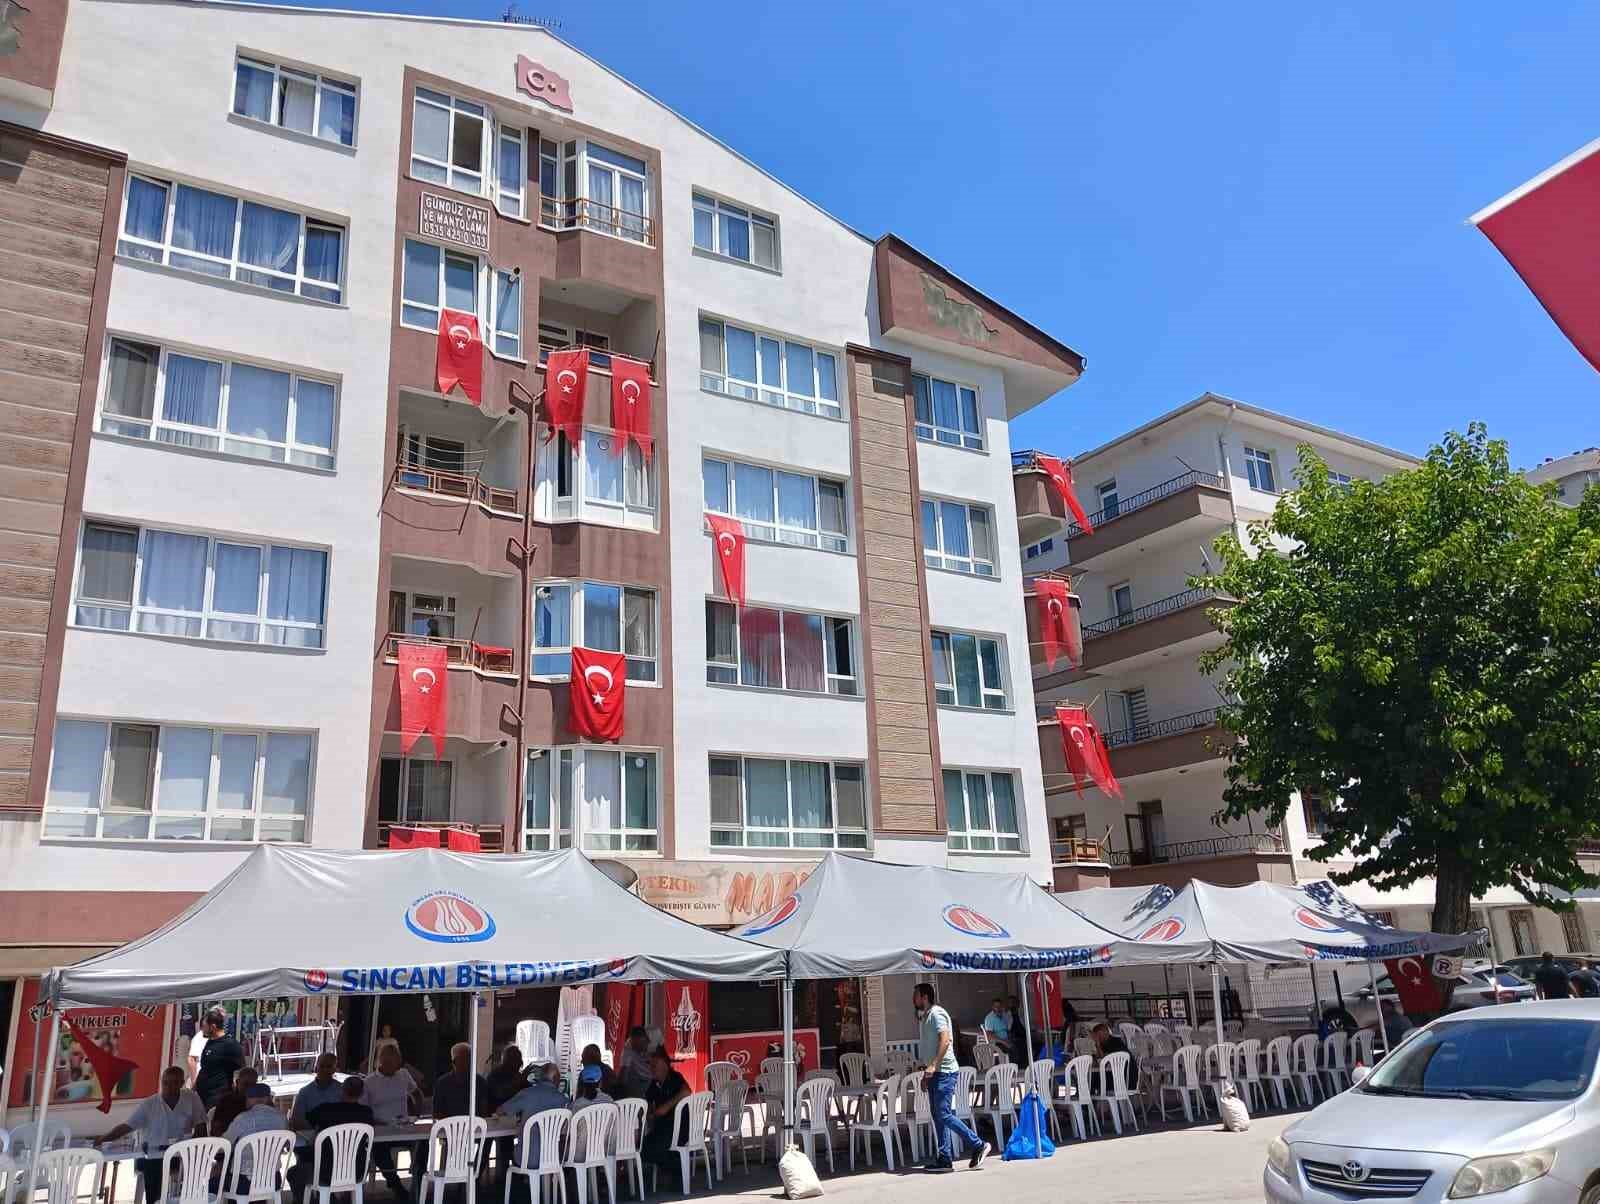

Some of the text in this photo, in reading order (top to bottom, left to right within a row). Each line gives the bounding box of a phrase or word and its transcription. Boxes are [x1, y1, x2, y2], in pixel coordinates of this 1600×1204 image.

[423, 209, 488, 235] VE MANTOLAMA
[466, 207, 487, 222] ÇATI
[424, 222, 444, 236] 0535
